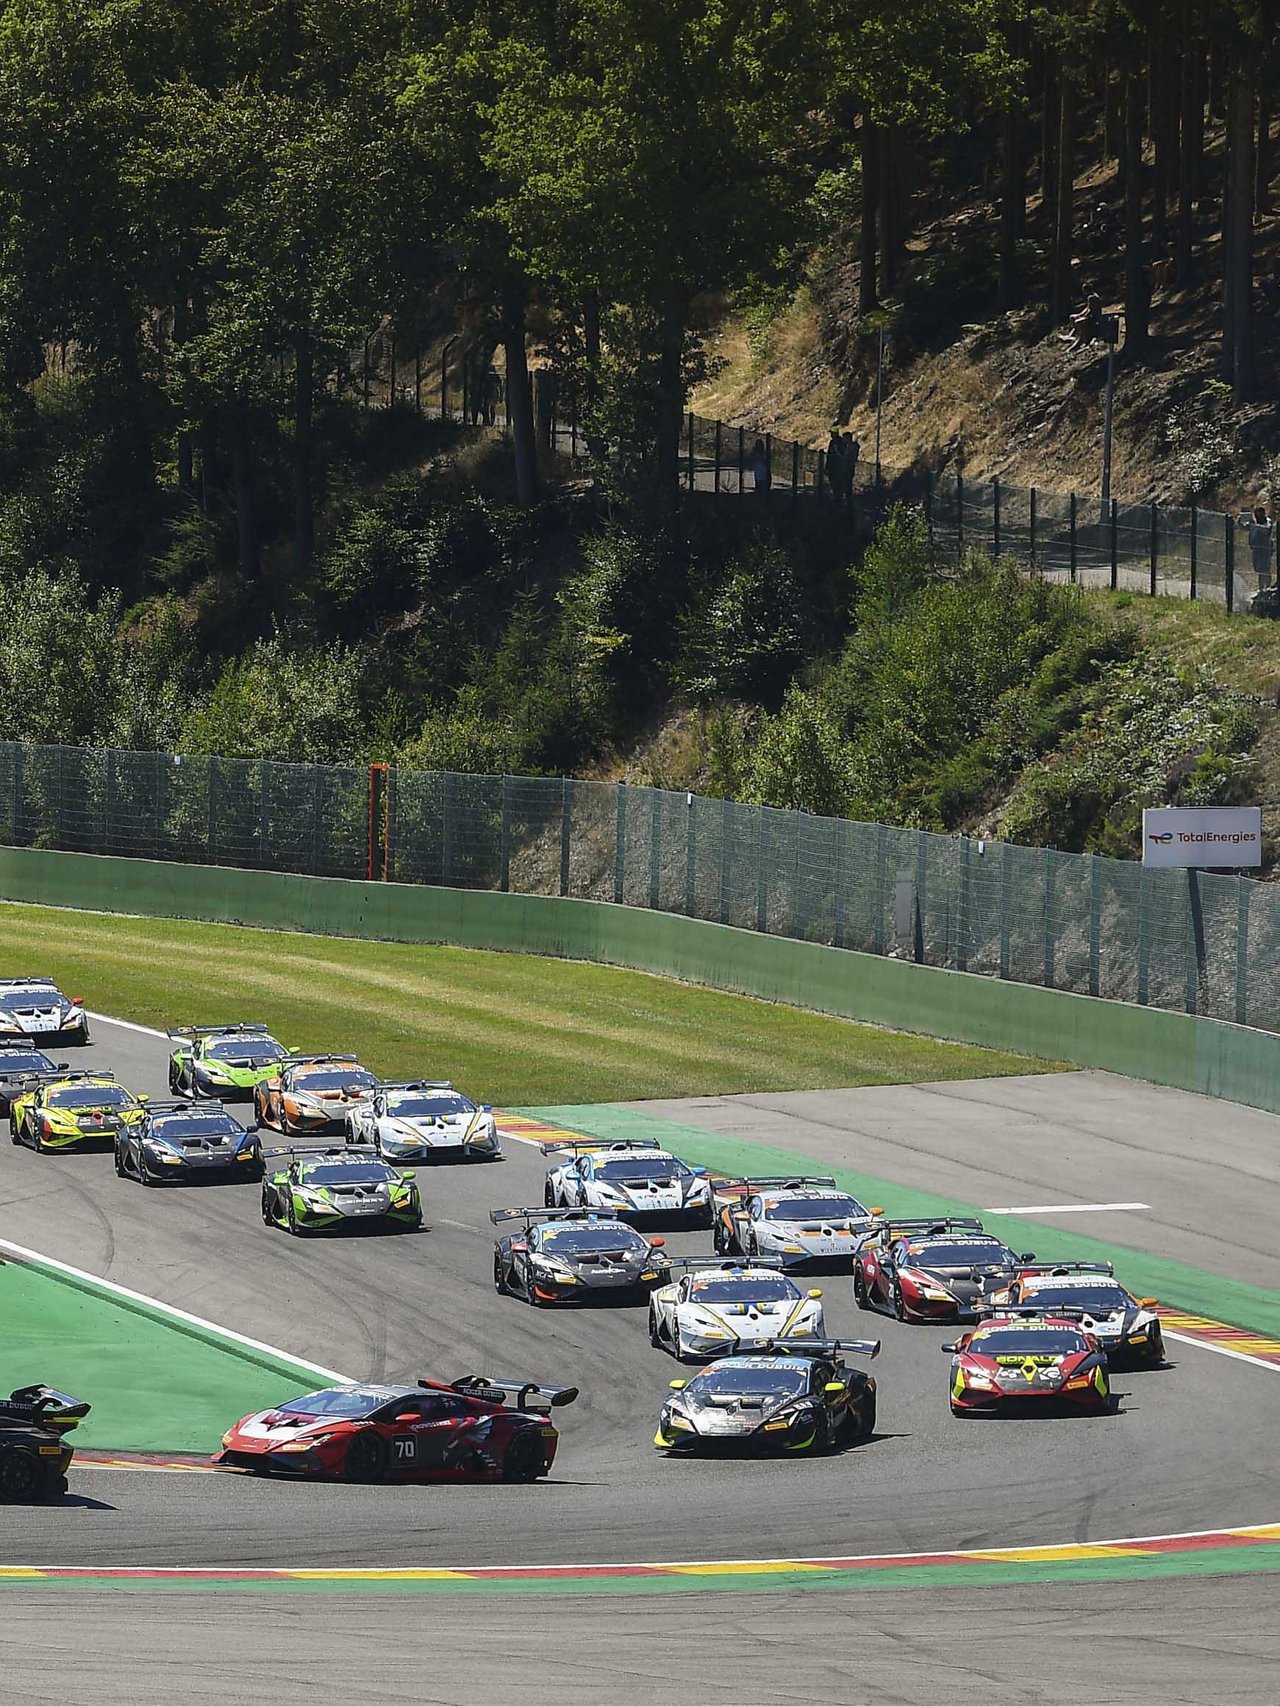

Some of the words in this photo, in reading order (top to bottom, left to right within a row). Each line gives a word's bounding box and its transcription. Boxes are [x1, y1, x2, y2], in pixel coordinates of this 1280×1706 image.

[1177, 832, 1256, 844] TotalEnergies
[9, 1401, 36, 1411] DUBUI
[394, 1441, 415, 1459] 70
